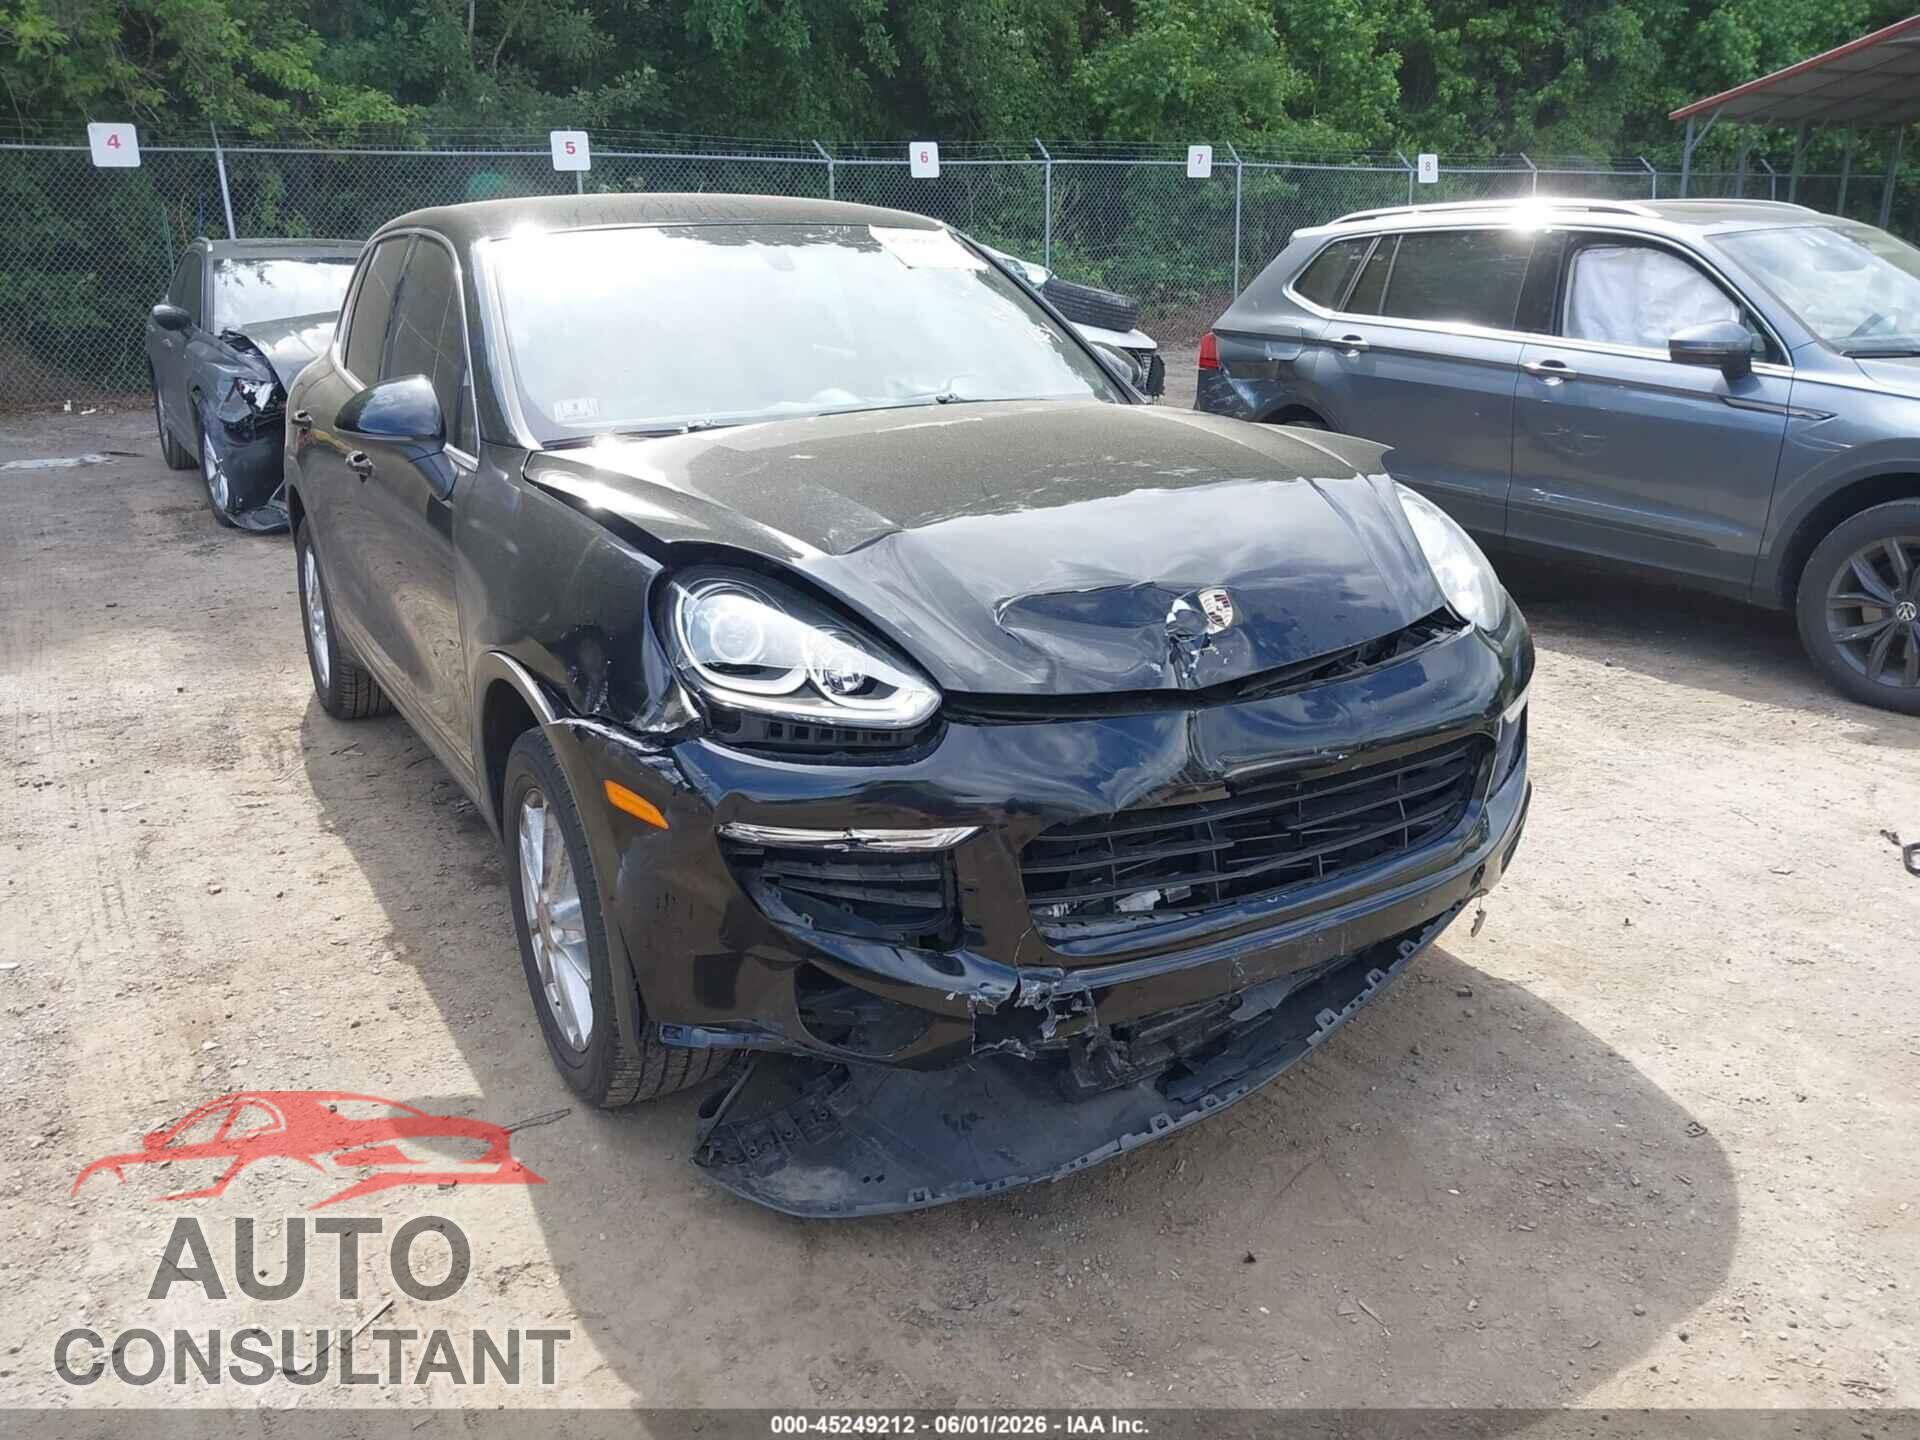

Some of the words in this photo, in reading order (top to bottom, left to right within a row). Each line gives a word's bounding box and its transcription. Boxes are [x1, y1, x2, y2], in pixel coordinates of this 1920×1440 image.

[106, 133, 122, 149] 4
[565, 141, 577, 155] 5
[920, 151, 929, 164] 6
[1197, 154, 1204, 165] 7
[1424, 161, 1432, 172] 8
